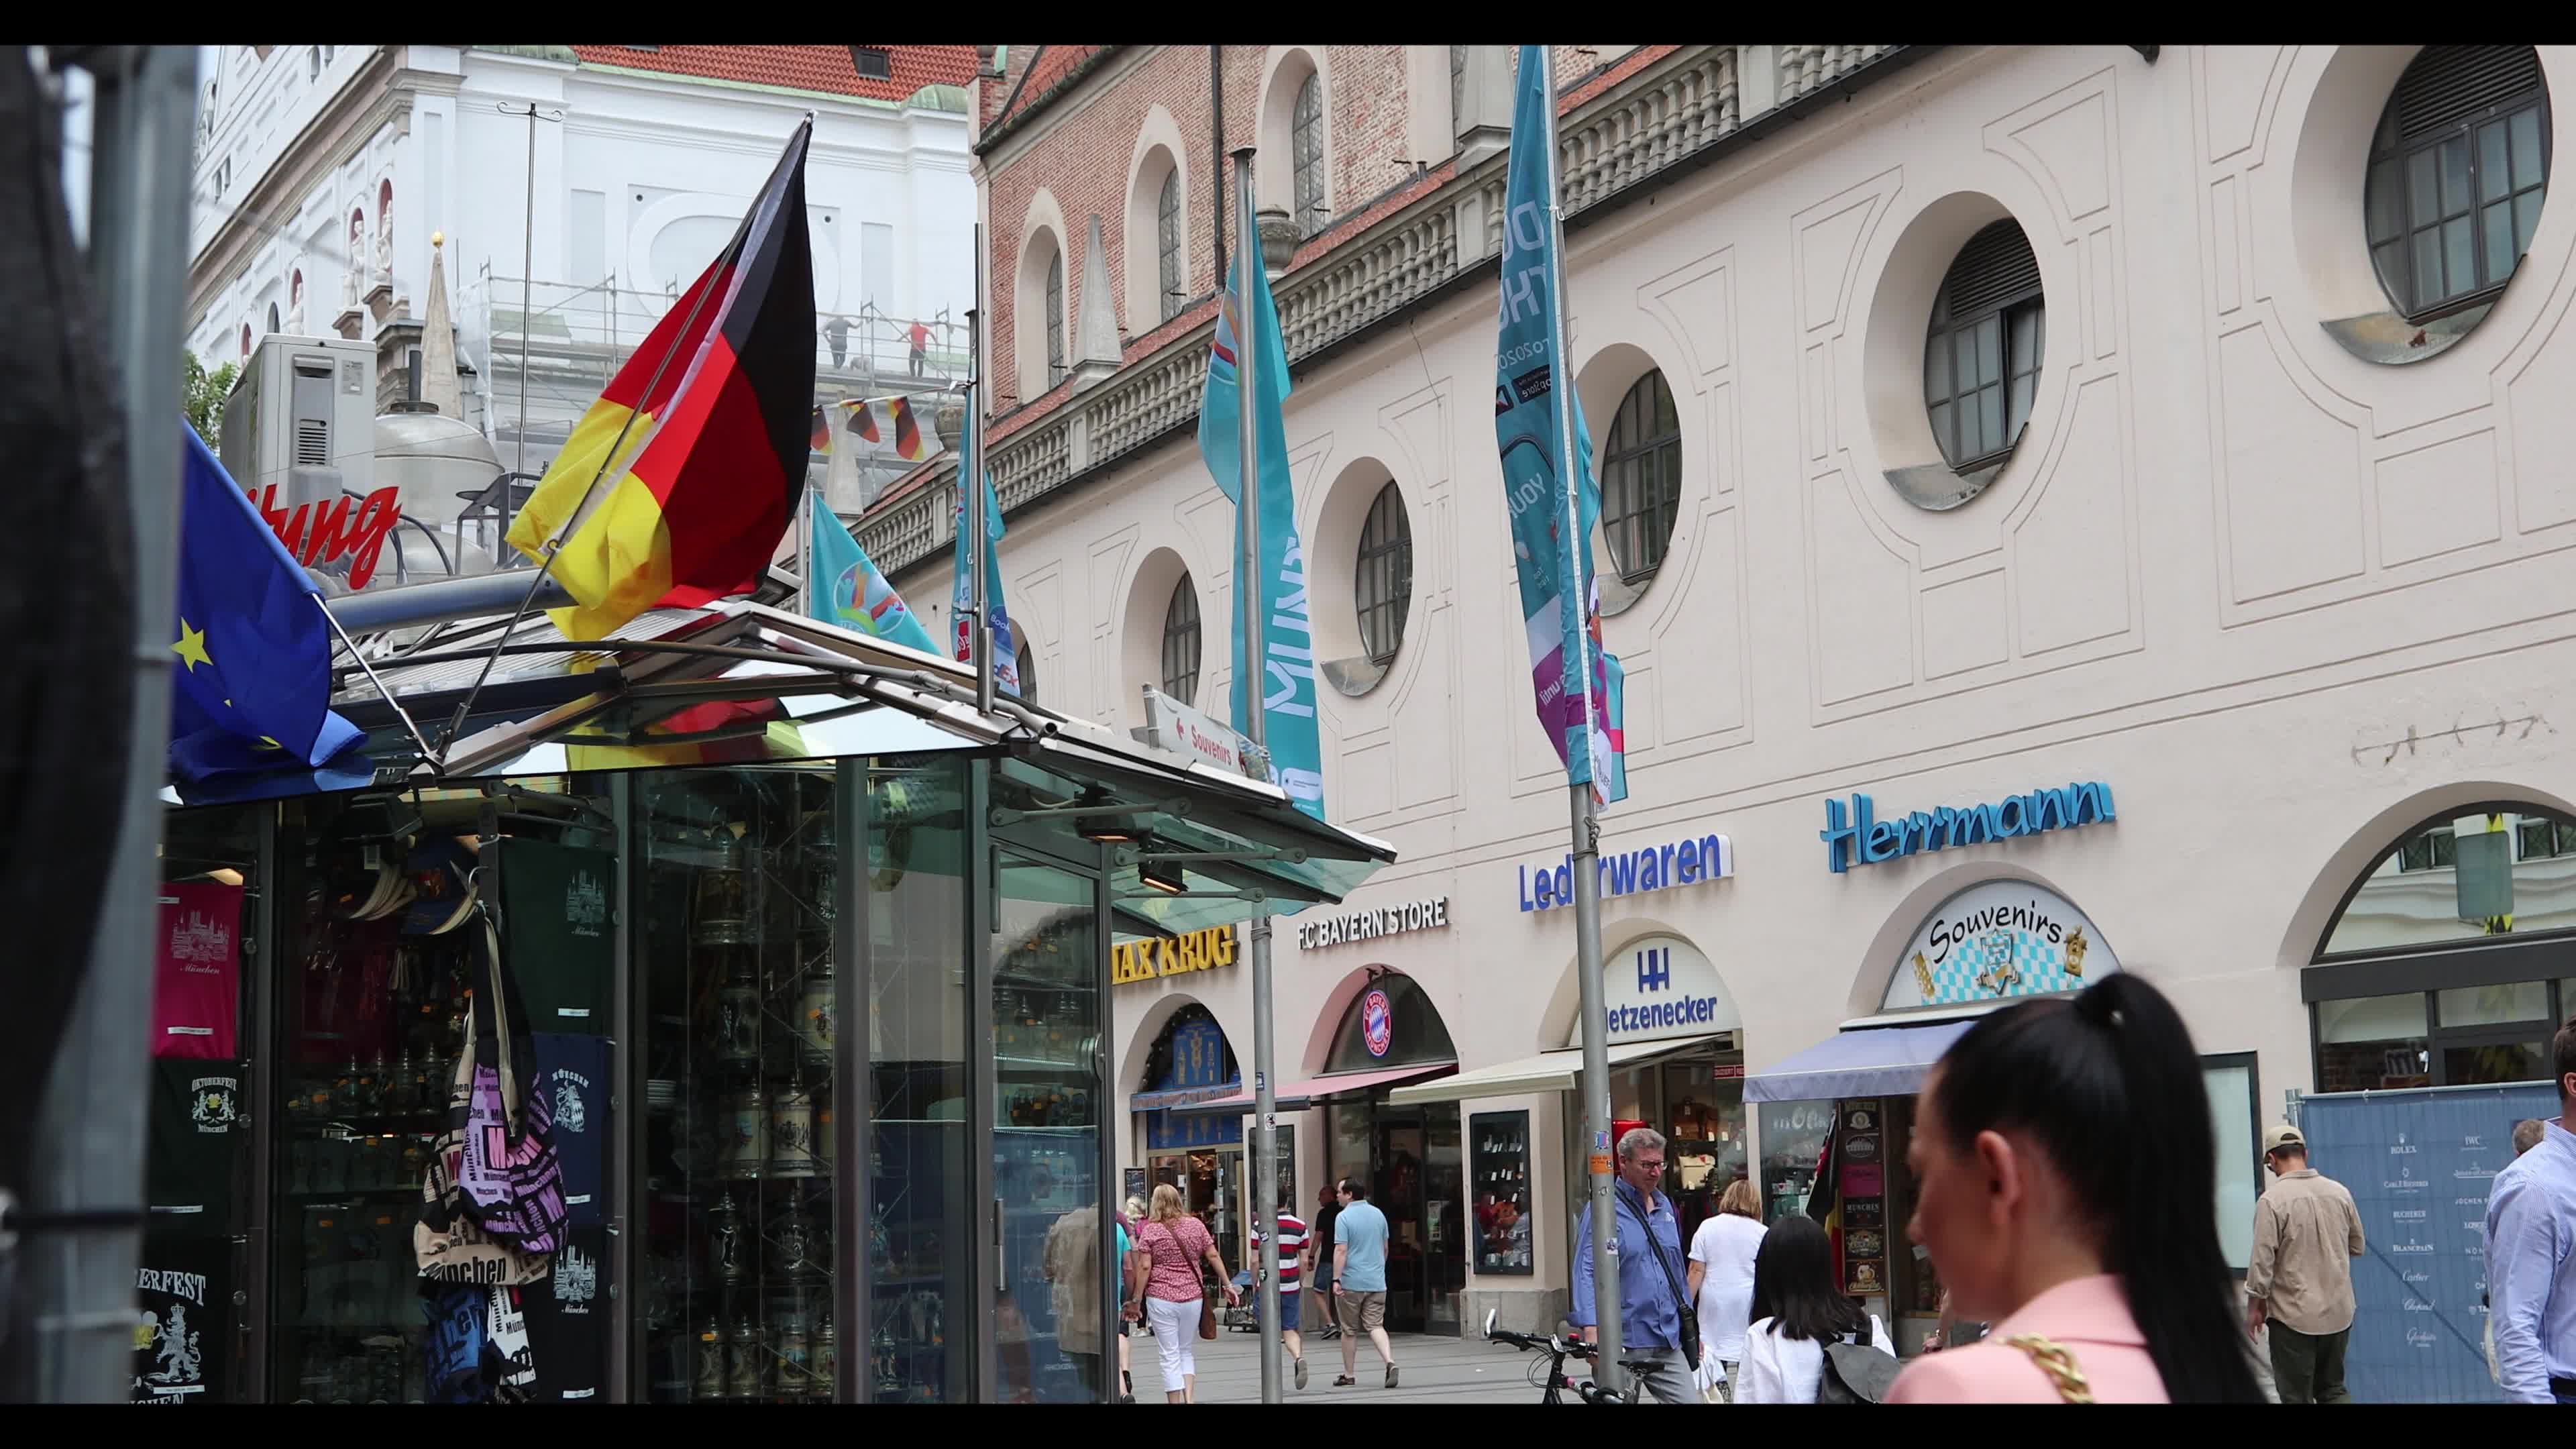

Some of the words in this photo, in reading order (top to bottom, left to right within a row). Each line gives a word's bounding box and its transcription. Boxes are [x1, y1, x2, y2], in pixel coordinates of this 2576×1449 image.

[1191, 724, 1232, 766] Souvenirs
[1820, 782, 2112, 873] Herrmann
[1519, 833, 1722, 912] Ledrwaren
[1297, 920, 1316, 950] FC
[1319, 907, 1385, 947] BAYERN
[1388, 896, 1448, 934] STORE
[1930, 901, 2062, 963] Souvenirs
[1158, 925, 1235, 977] KRUG
[1605, 995, 1718, 1034] etzenecker
[191, 1076, 237, 1093] OKTOBERFEST
[137, 1267, 207, 1307] ERFEST
